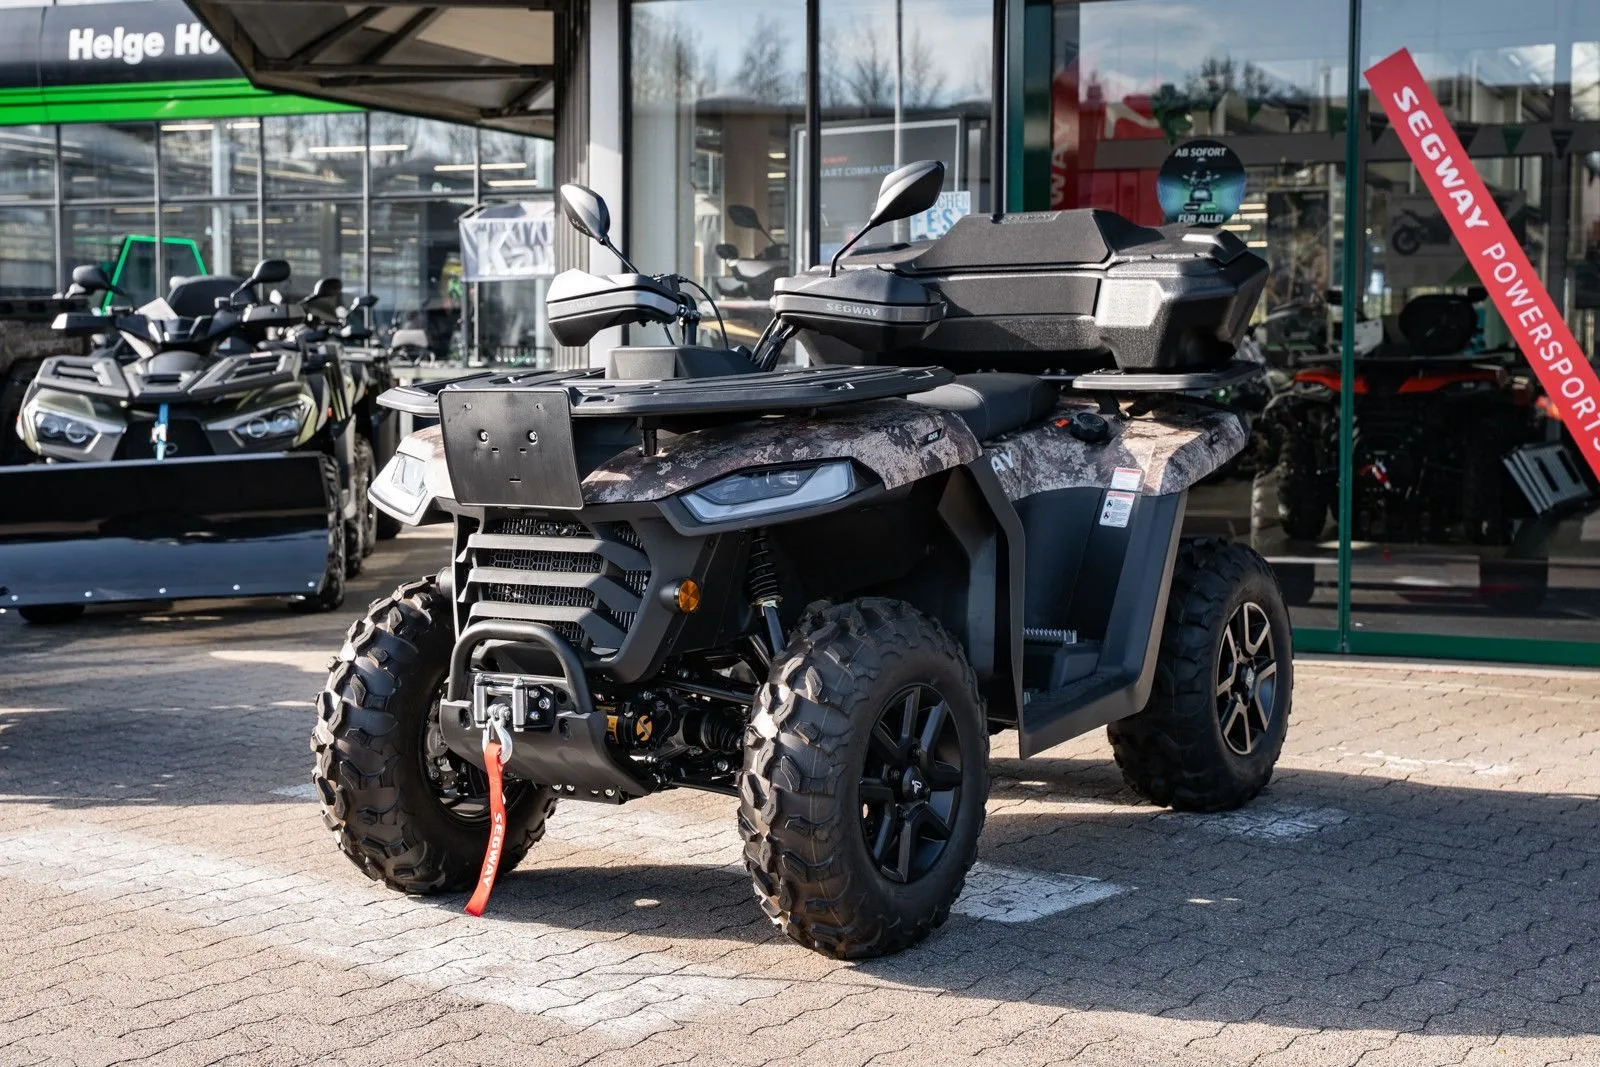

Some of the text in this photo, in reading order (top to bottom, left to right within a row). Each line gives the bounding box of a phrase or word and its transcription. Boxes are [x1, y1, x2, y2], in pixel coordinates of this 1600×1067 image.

[68, 22, 221, 65] Helge Ho
[1051, 117, 1071, 206] WAY
[1174, 147, 1227, 157] AB SOFORT
[1393, 86, 1489, 229] SEGWAY
[935, 193, 969, 208] CHEN
[826, 303, 879, 317] SEGWAY
[991, 450, 1014, 473] AY
[483, 812, 502, 888] SEGWAY
